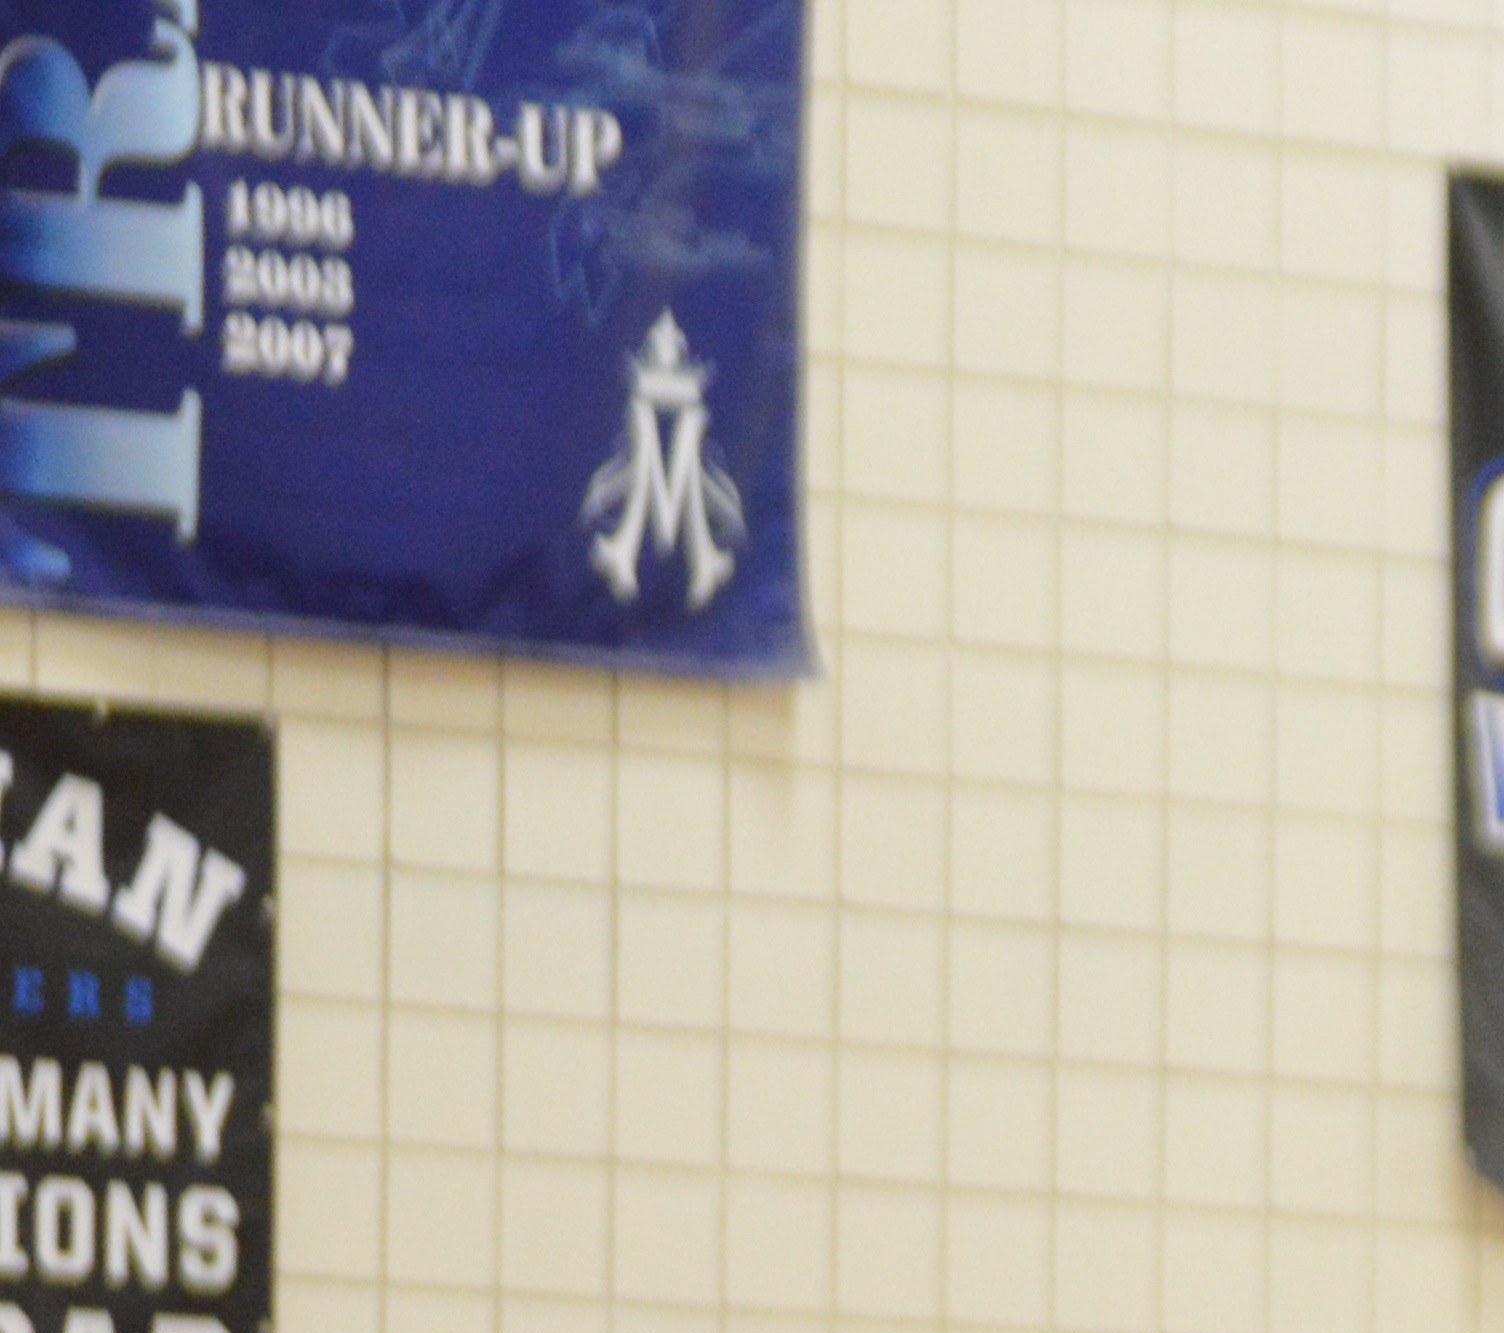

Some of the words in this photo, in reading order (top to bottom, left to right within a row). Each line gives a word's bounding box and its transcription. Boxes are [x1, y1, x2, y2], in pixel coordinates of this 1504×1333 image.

[203, 62, 622, 193] RUNNER-UP
[223, 245, 353, 316] 2003
[223, 312, 353, 386] 2007
[0, 748, 247, 974] AN
[0, 1055, 235, 1163] MANY
